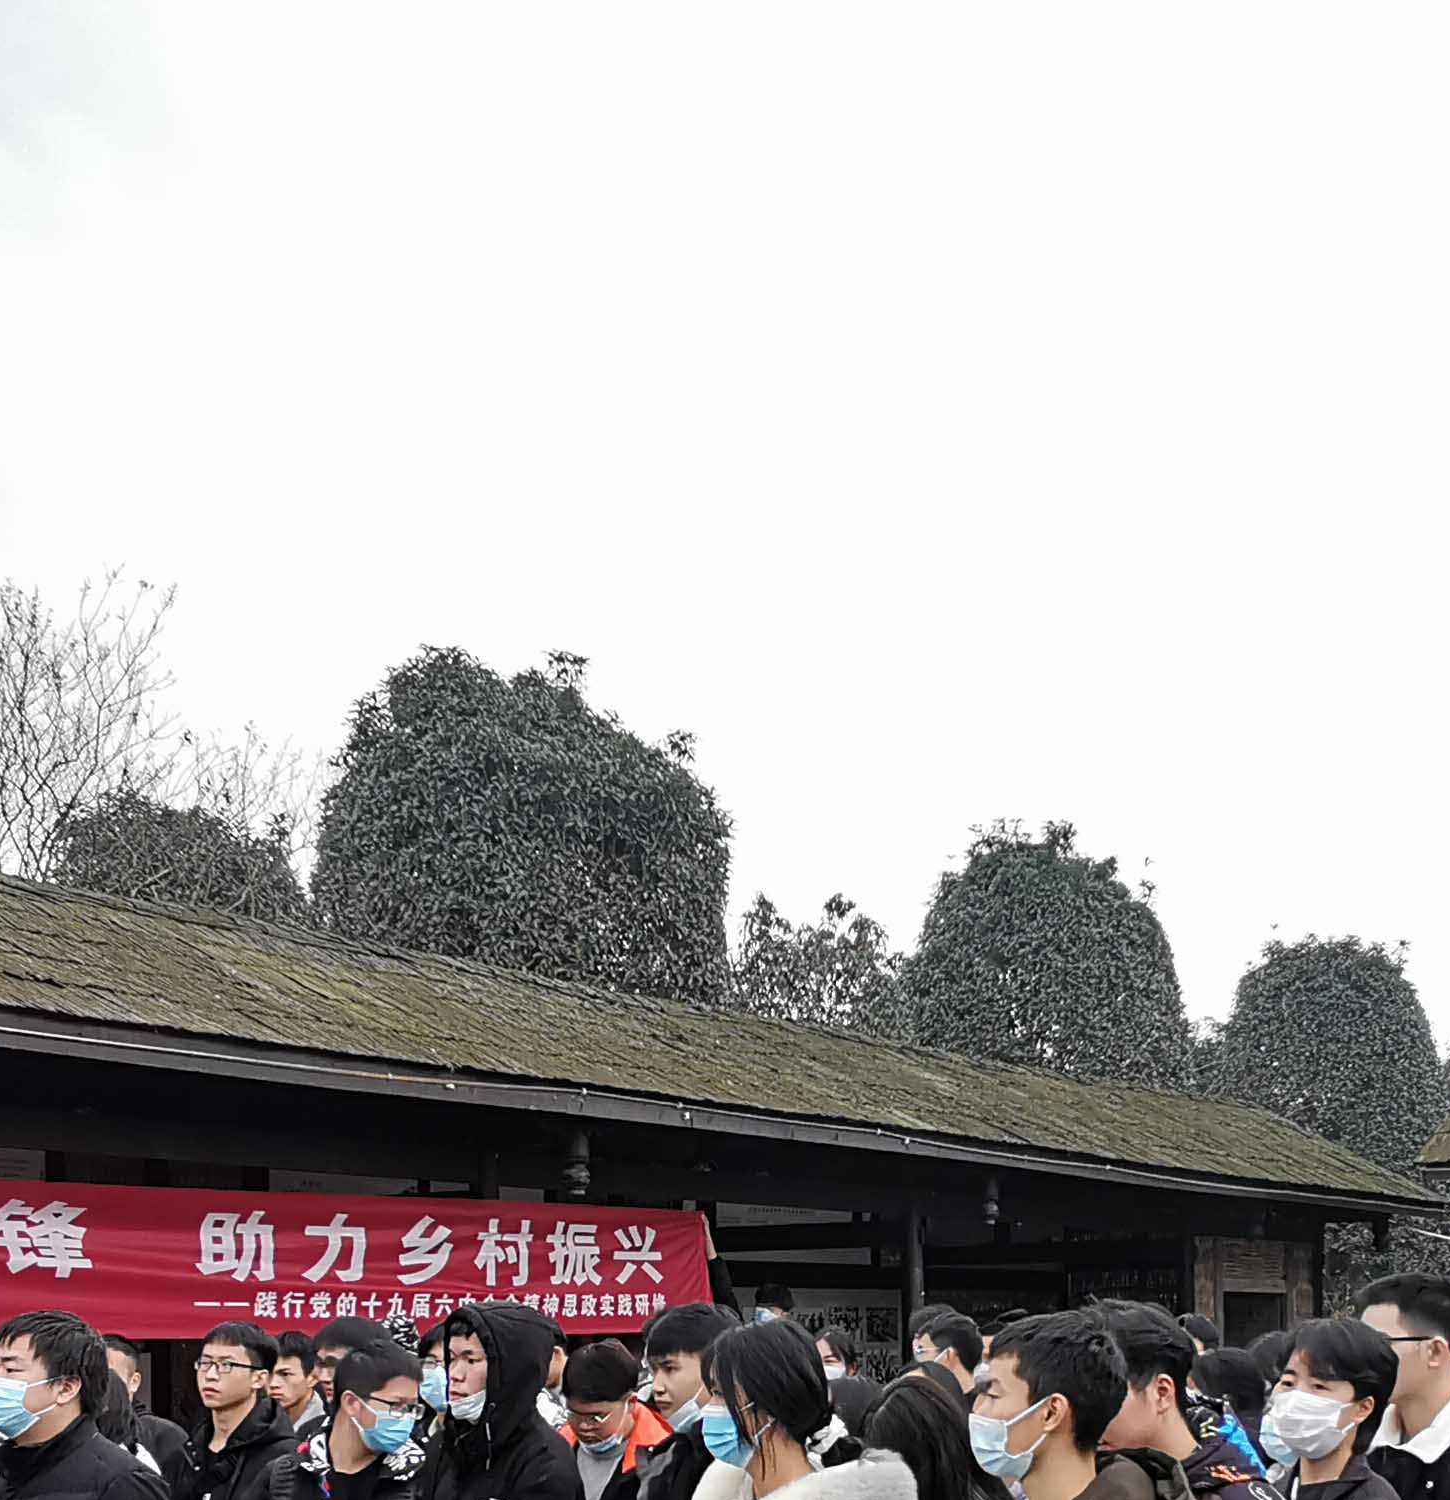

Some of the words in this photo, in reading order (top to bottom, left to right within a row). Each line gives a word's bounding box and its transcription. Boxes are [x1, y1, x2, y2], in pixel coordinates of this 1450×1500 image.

[195, 1209, 665, 1286] 助力乡村振兴
